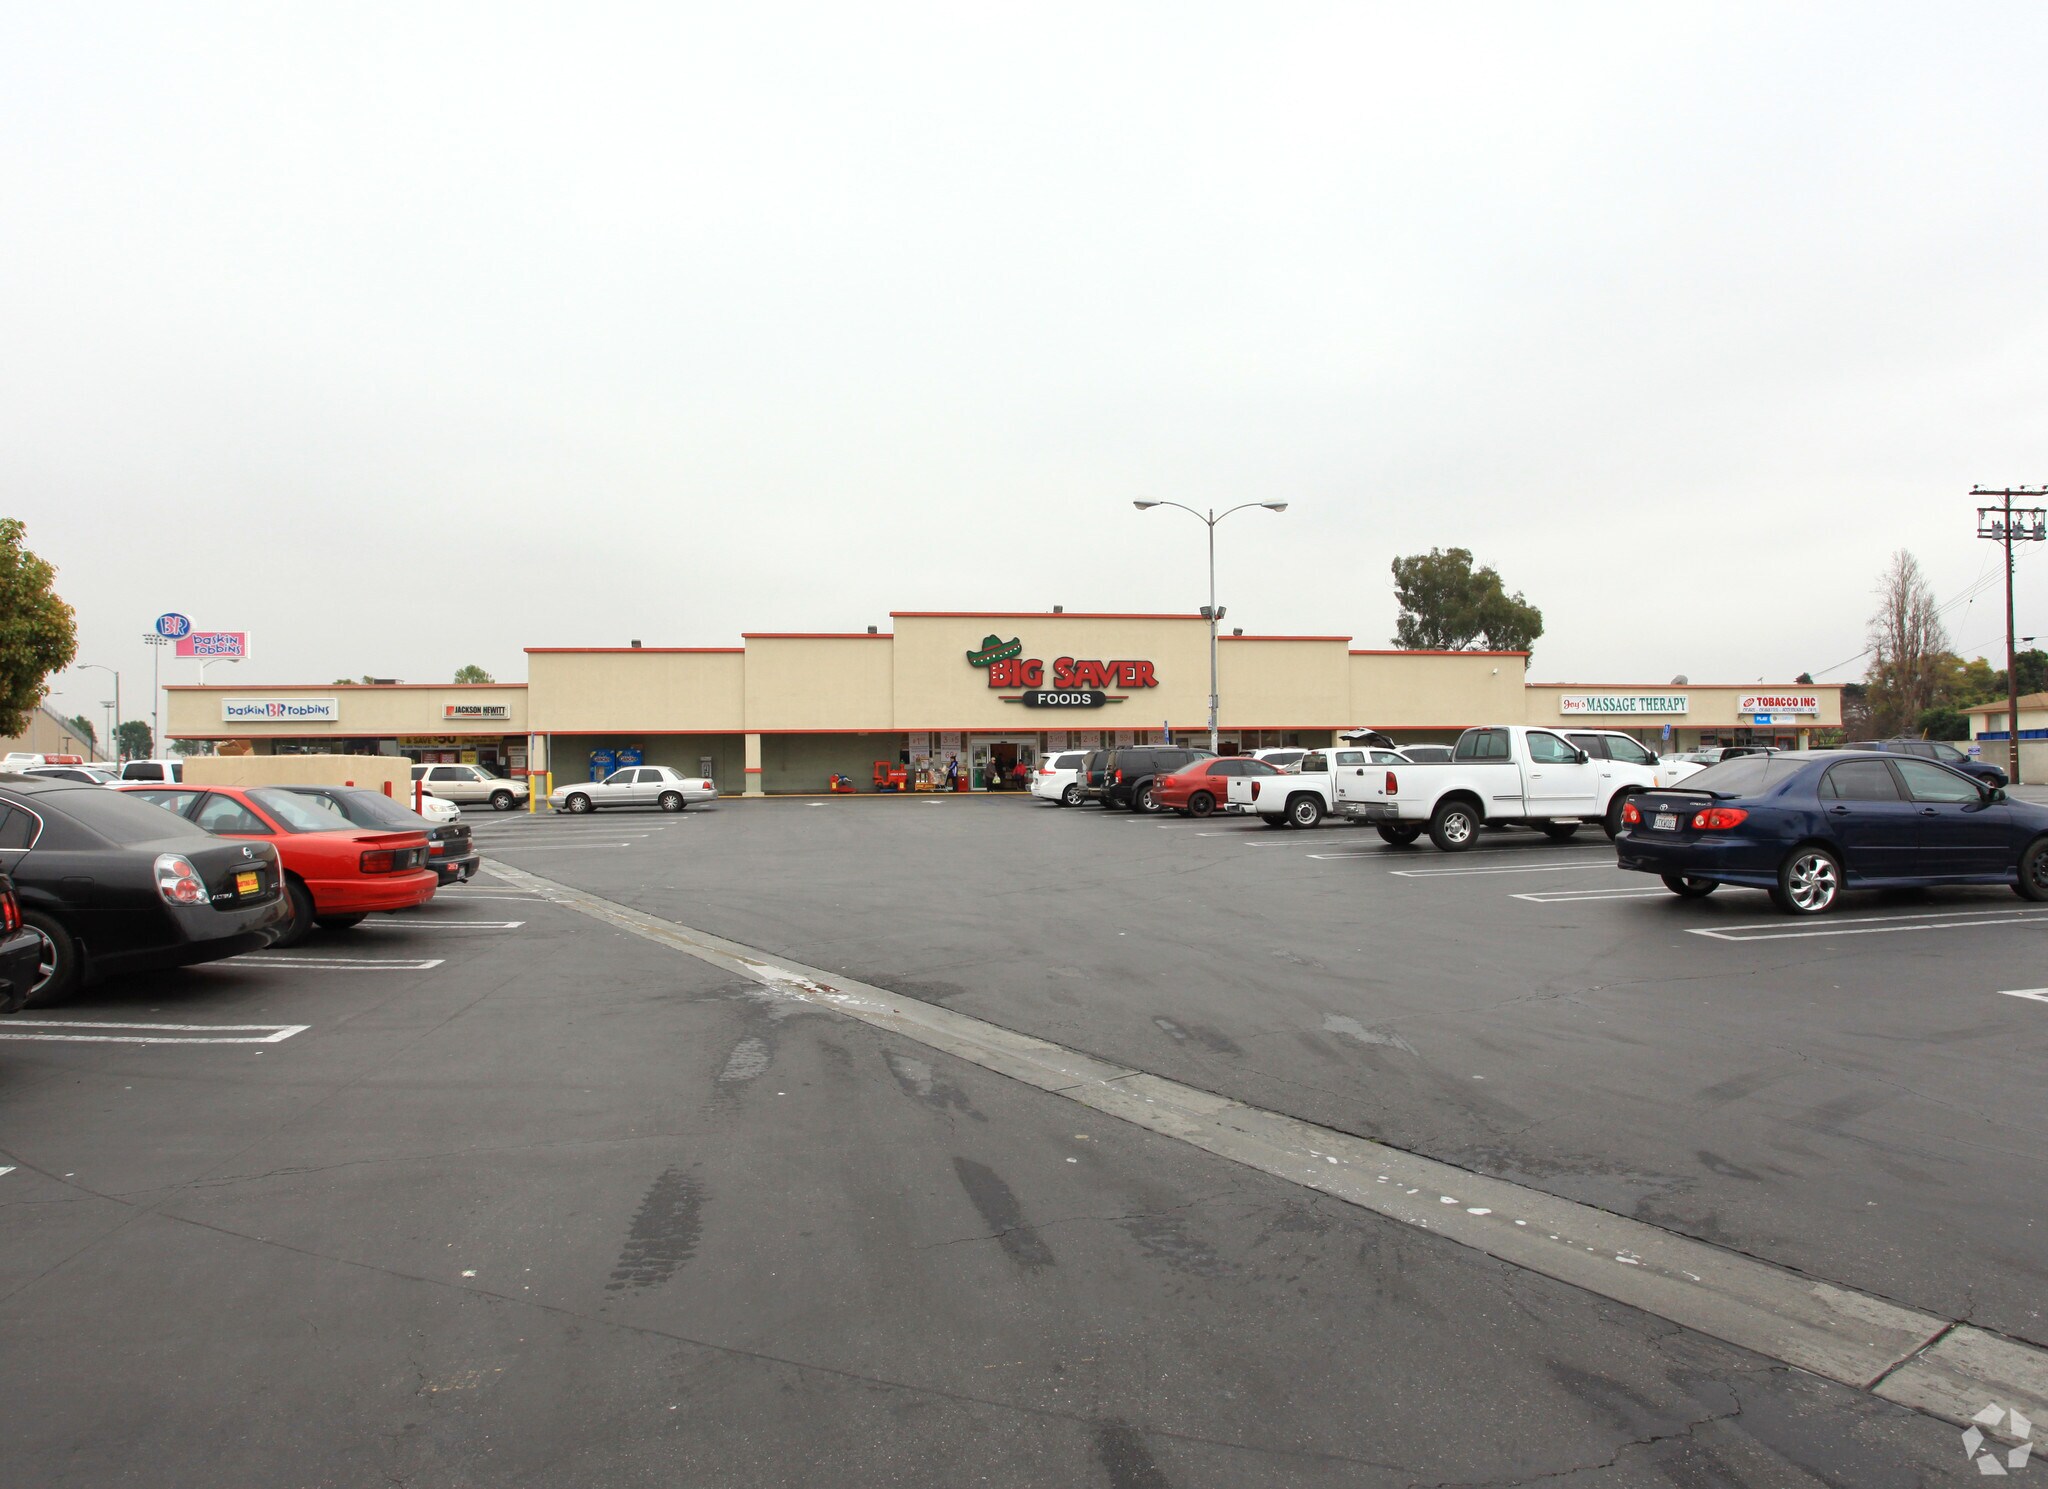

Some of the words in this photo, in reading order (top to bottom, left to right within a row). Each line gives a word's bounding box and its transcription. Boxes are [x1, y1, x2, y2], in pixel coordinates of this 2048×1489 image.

[159, 616, 188, 635] BR
[192, 633, 238, 645] baskin
[194, 644, 242, 655] robbins
[988, 658, 1045, 689] BIG
[1053, 656, 1160, 689] SAVER
[1037, 693, 1092, 705] FOODS
[1586, 697, 1637, 712] MASSAGE
[1638, 697, 1687, 712] THERAPY
[1756, 697, 1799, 707] TOBACCO
[1800, 697, 1816, 707] INC
[227, 705, 265, 715] baskin
[287, 704, 330, 716] robbins
